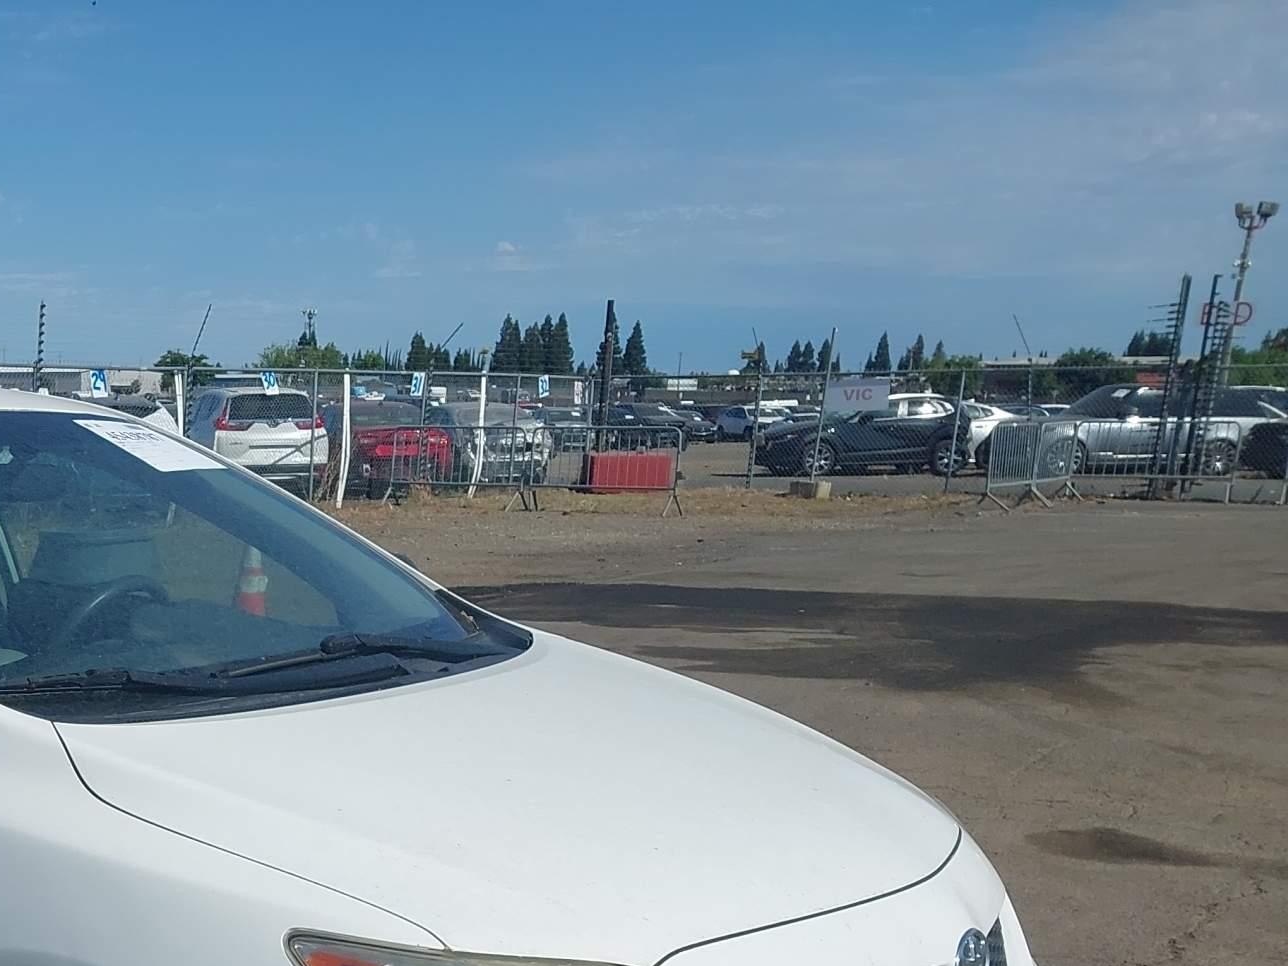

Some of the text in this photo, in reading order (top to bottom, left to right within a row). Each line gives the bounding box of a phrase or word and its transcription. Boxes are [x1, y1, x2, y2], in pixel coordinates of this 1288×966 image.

[91, 370, 107, 392] 29
[263, 371, 276, 390] 30
[412, 376, 423, 395] 31
[540, 378, 549, 395] 32
[843, 388, 873, 401] VIC
